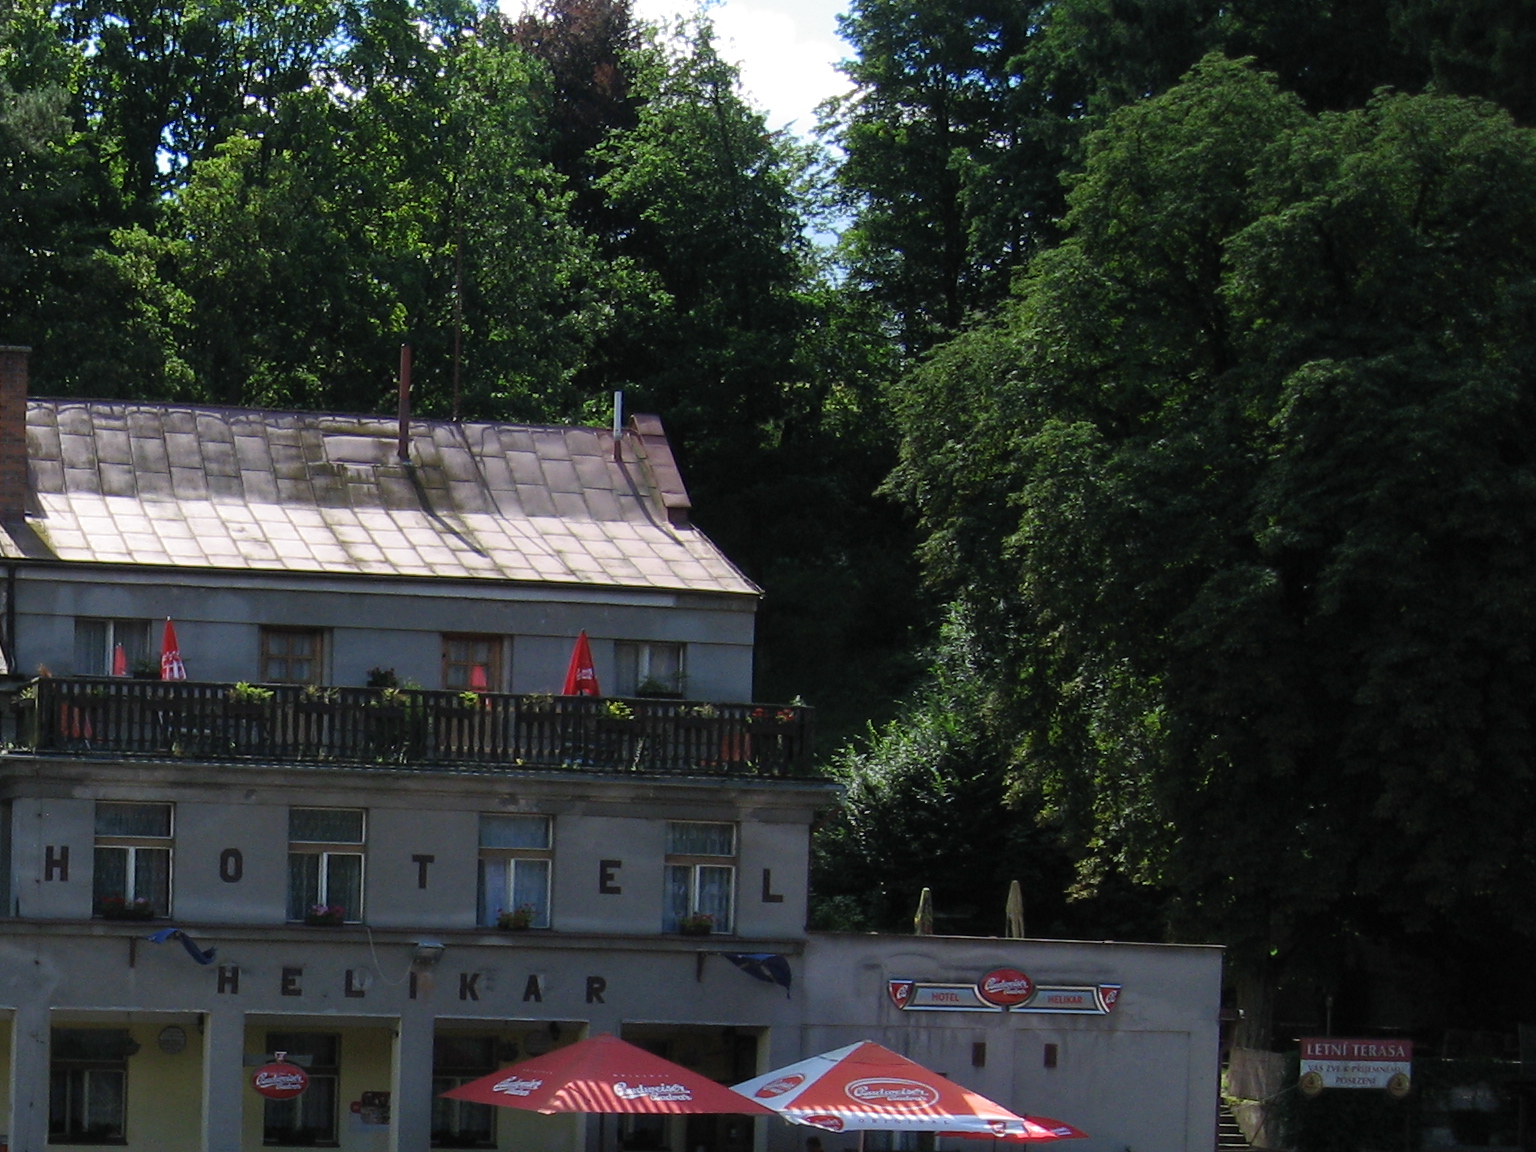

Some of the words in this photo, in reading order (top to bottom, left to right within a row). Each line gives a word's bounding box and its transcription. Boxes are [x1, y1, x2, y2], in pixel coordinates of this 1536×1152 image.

[45, 845, 784, 904] HOTEL
[216, 965, 607, 1005] HELIKAR
[931, 992, 959, 1002] HOTEL
[1047, 995, 1083, 1004] HELIKAR
[1307, 1041, 1348, 1056] LETNÍ
[1353, 1044, 1406, 1058] TERASA
[613, 1081, 692, 1100] Budweiser
[853, 1086, 930, 1099] Budweiser
